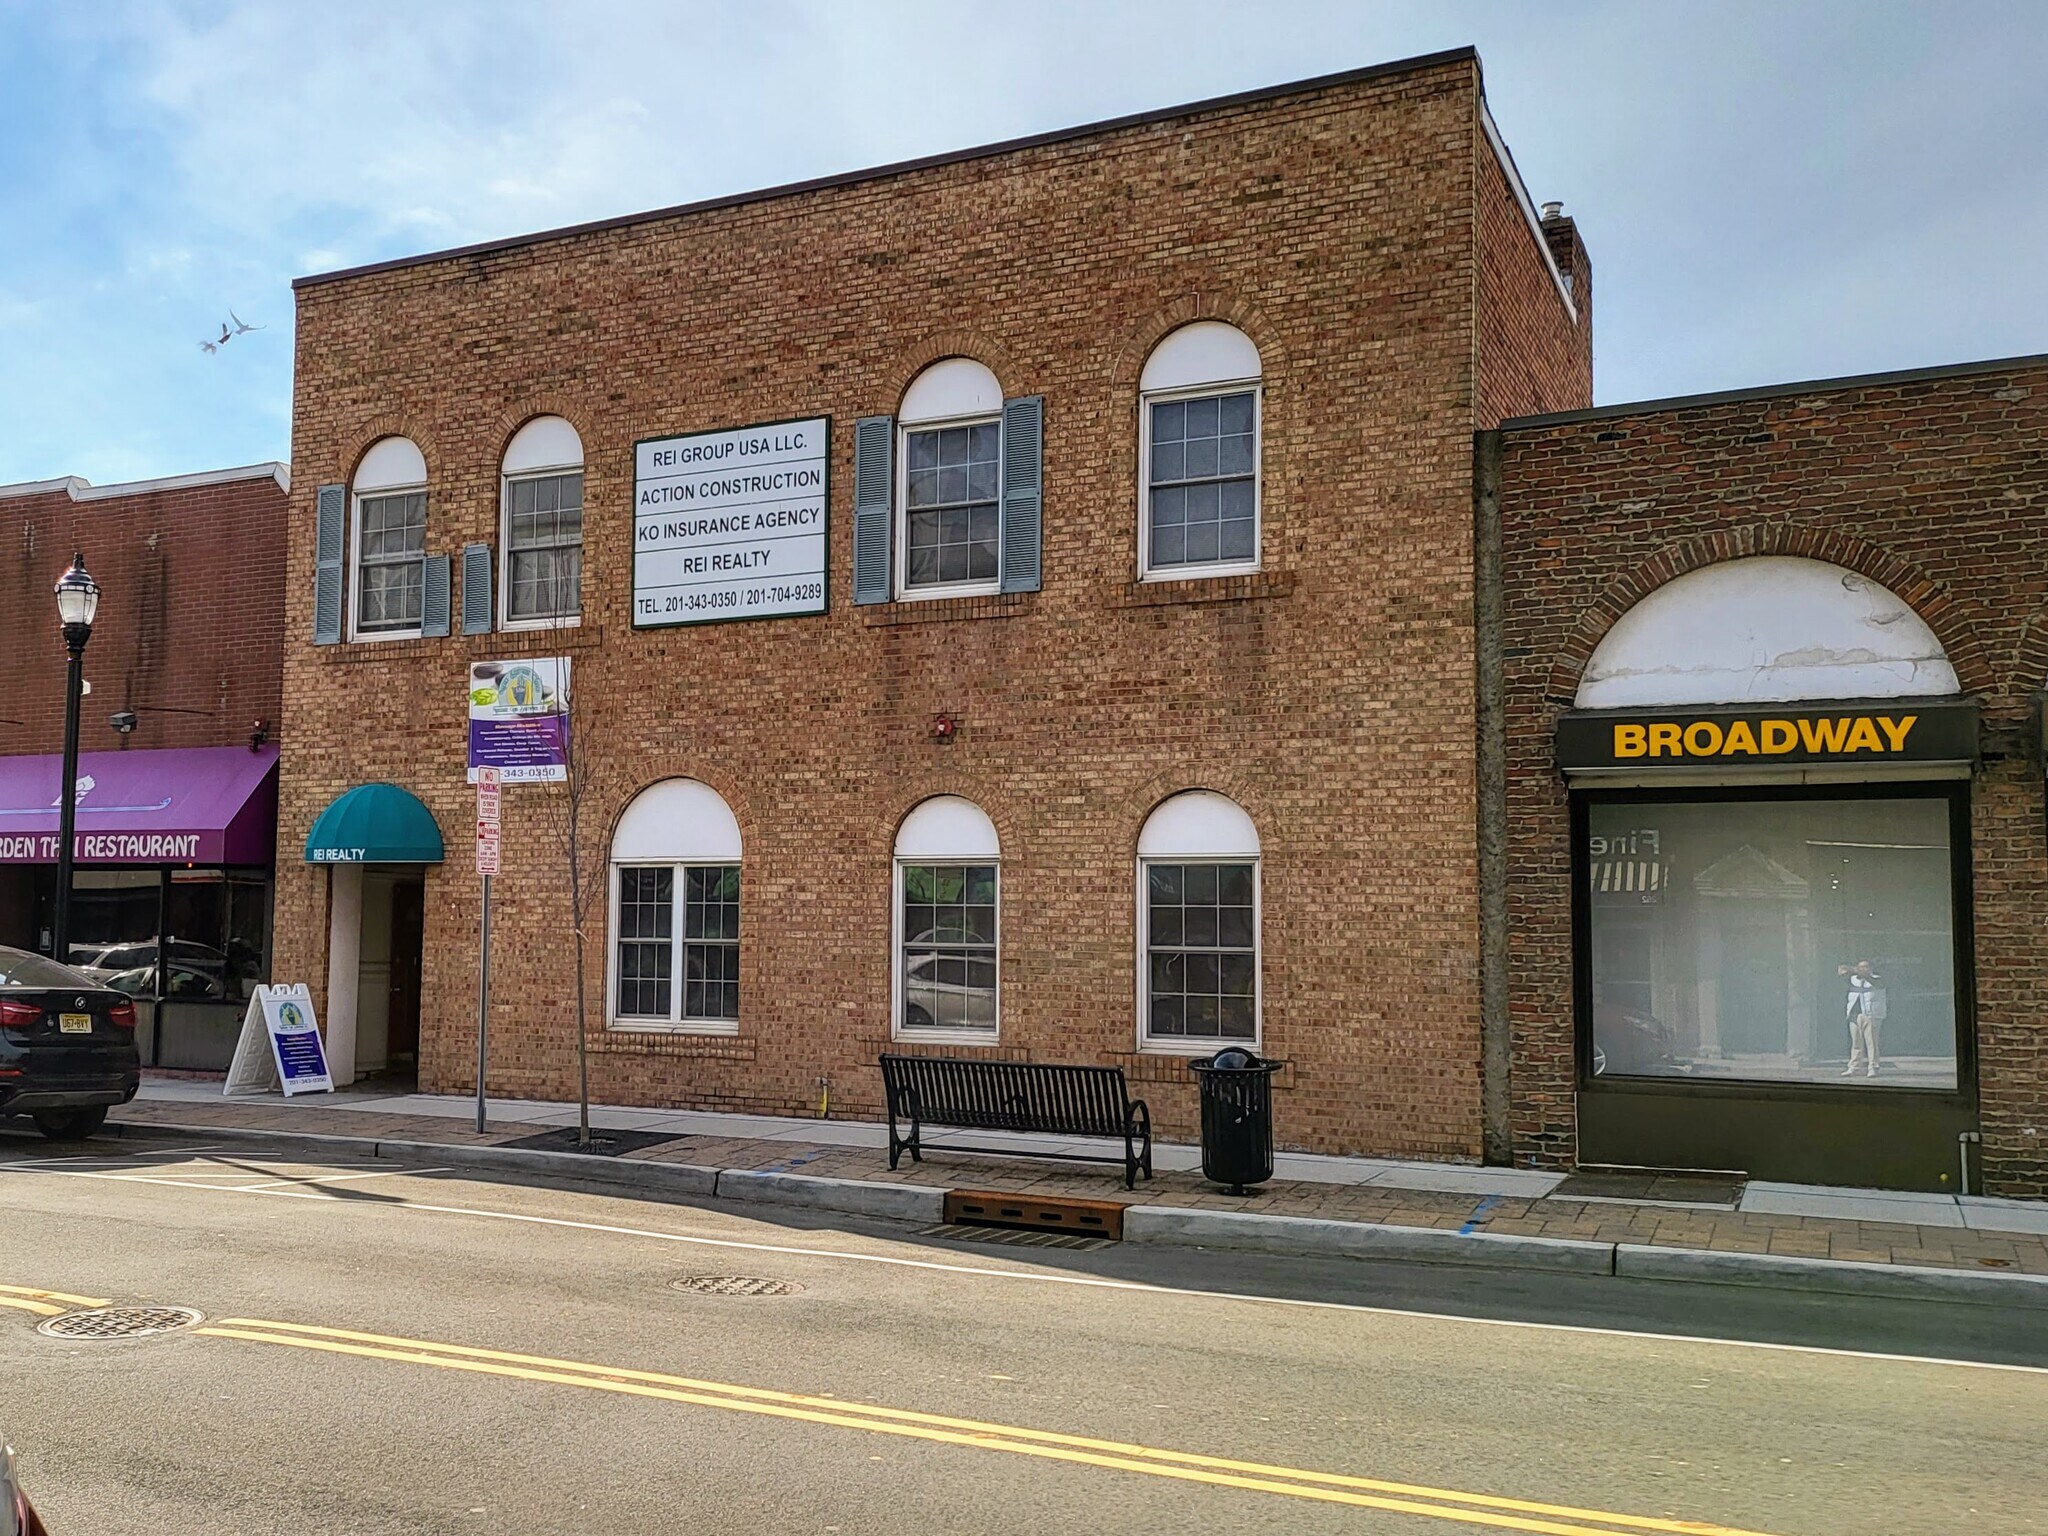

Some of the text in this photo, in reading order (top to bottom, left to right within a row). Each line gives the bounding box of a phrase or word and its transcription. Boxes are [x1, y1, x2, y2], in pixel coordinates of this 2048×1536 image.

[653, 434, 808, 467] REI GROUP USA LLC.
[640, 470, 820, 506] ACTION CONSTRUCTION
[638, 508, 820, 542] KO INSURANCE AGENCY
[684, 550, 770, 574] REI REALTY
[638, 599, 662, 614] TEL.
[665, 592, 737, 612] 201-343-0350
[746, 583, 822, 605] 201-704-9289
[1614, 715, 1918, 758] BROADWAY
[484, 772, 494, 782] NO
[500, 768, 556, 778] -343-0350
[480, 782, 498, 793] PARKING
[40, 836, 80, 858] THI
[84, 834, 200, 858] RESTAURANT
[313, 848, 366, 860] REI REALTY
